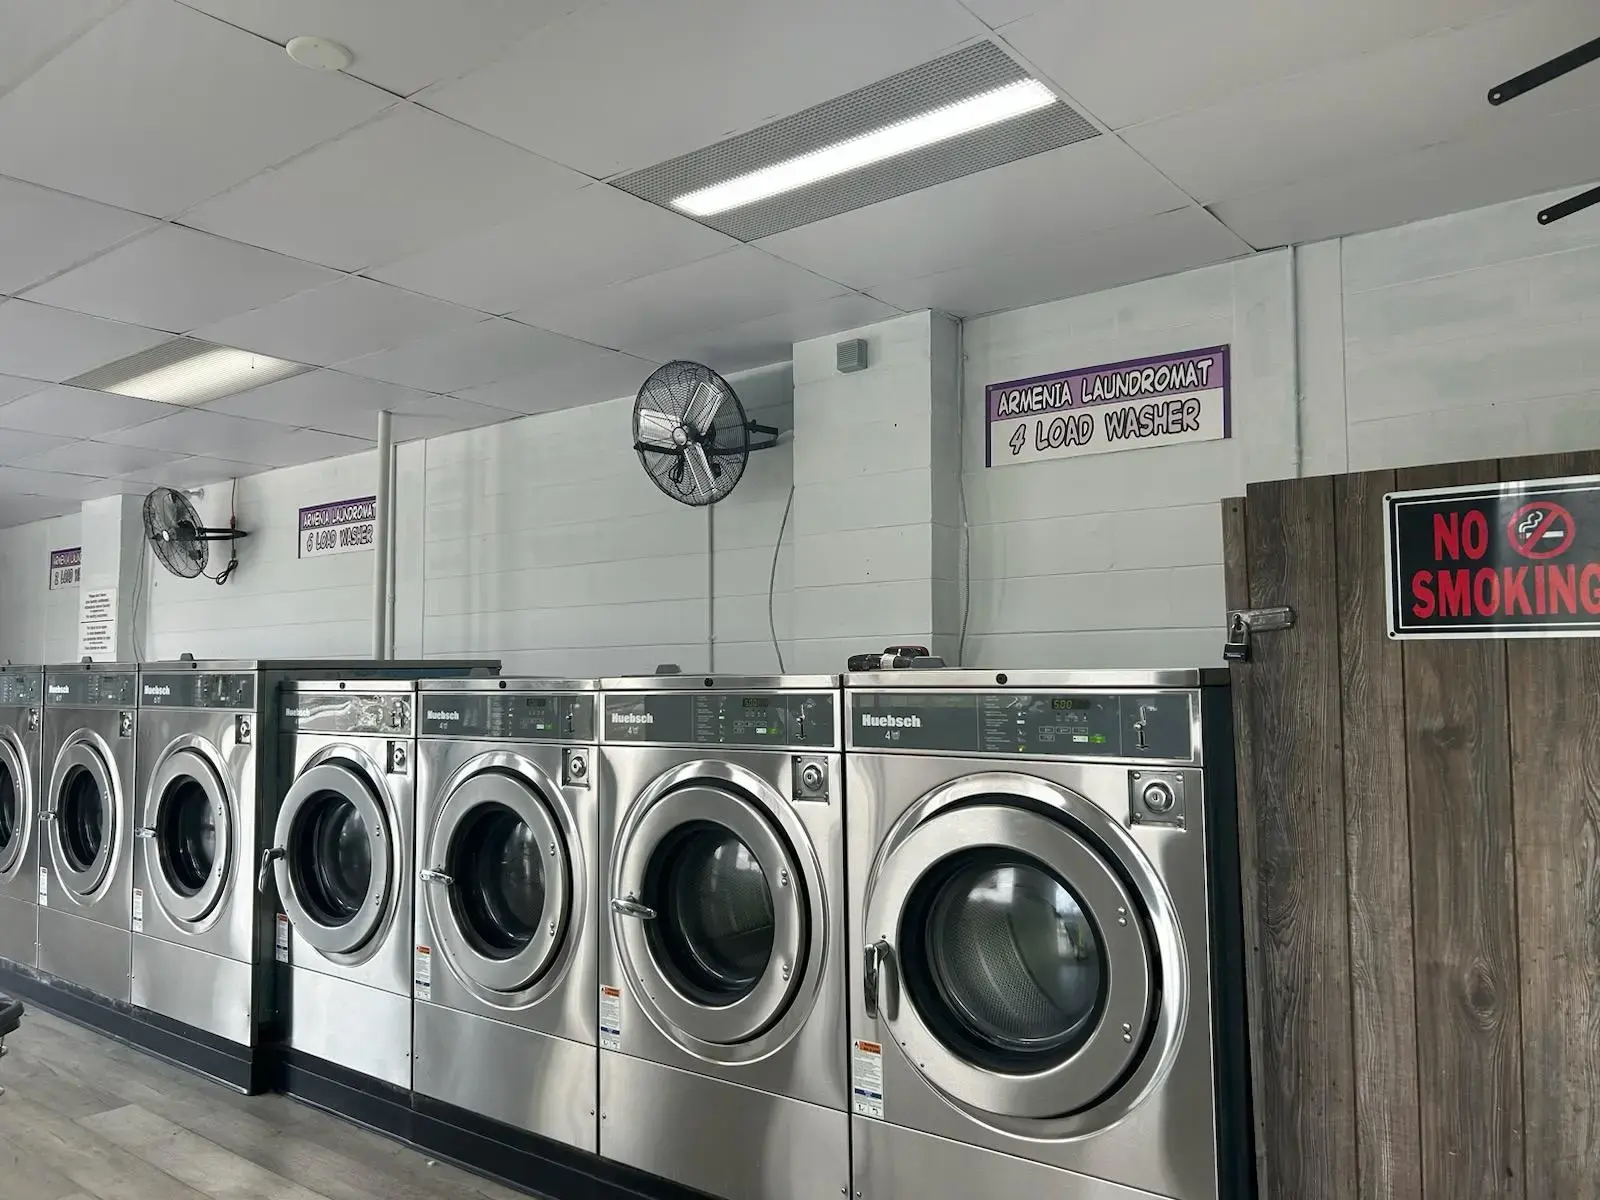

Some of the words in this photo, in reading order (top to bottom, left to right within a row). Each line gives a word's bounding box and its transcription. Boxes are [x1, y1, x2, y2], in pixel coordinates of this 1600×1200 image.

[998, 380, 1073, 416] ARMENIA
[1081, 358, 1213, 403] LAUNDROMAT
[1009, 424, 1026, 455] 4
[1035, 414, 1094, 451] LOAD
[1104, 398, 1200, 441] WASHER
[303, 509, 329, 528] ARMENIA
[306, 532, 314, 552] 6
[316, 529, 337, 550] LOAD
[340, 523, 373, 547] WASHER
[1433, 509, 1489, 560] NO
[1411, 562, 1600, 619] SMOKING
[427, 710, 459, 720] Huebsch
[611, 713, 654, 724] Huebsch
[862, 714, 921, 727] Huebsch
[884, 730, 891, 740] 4
